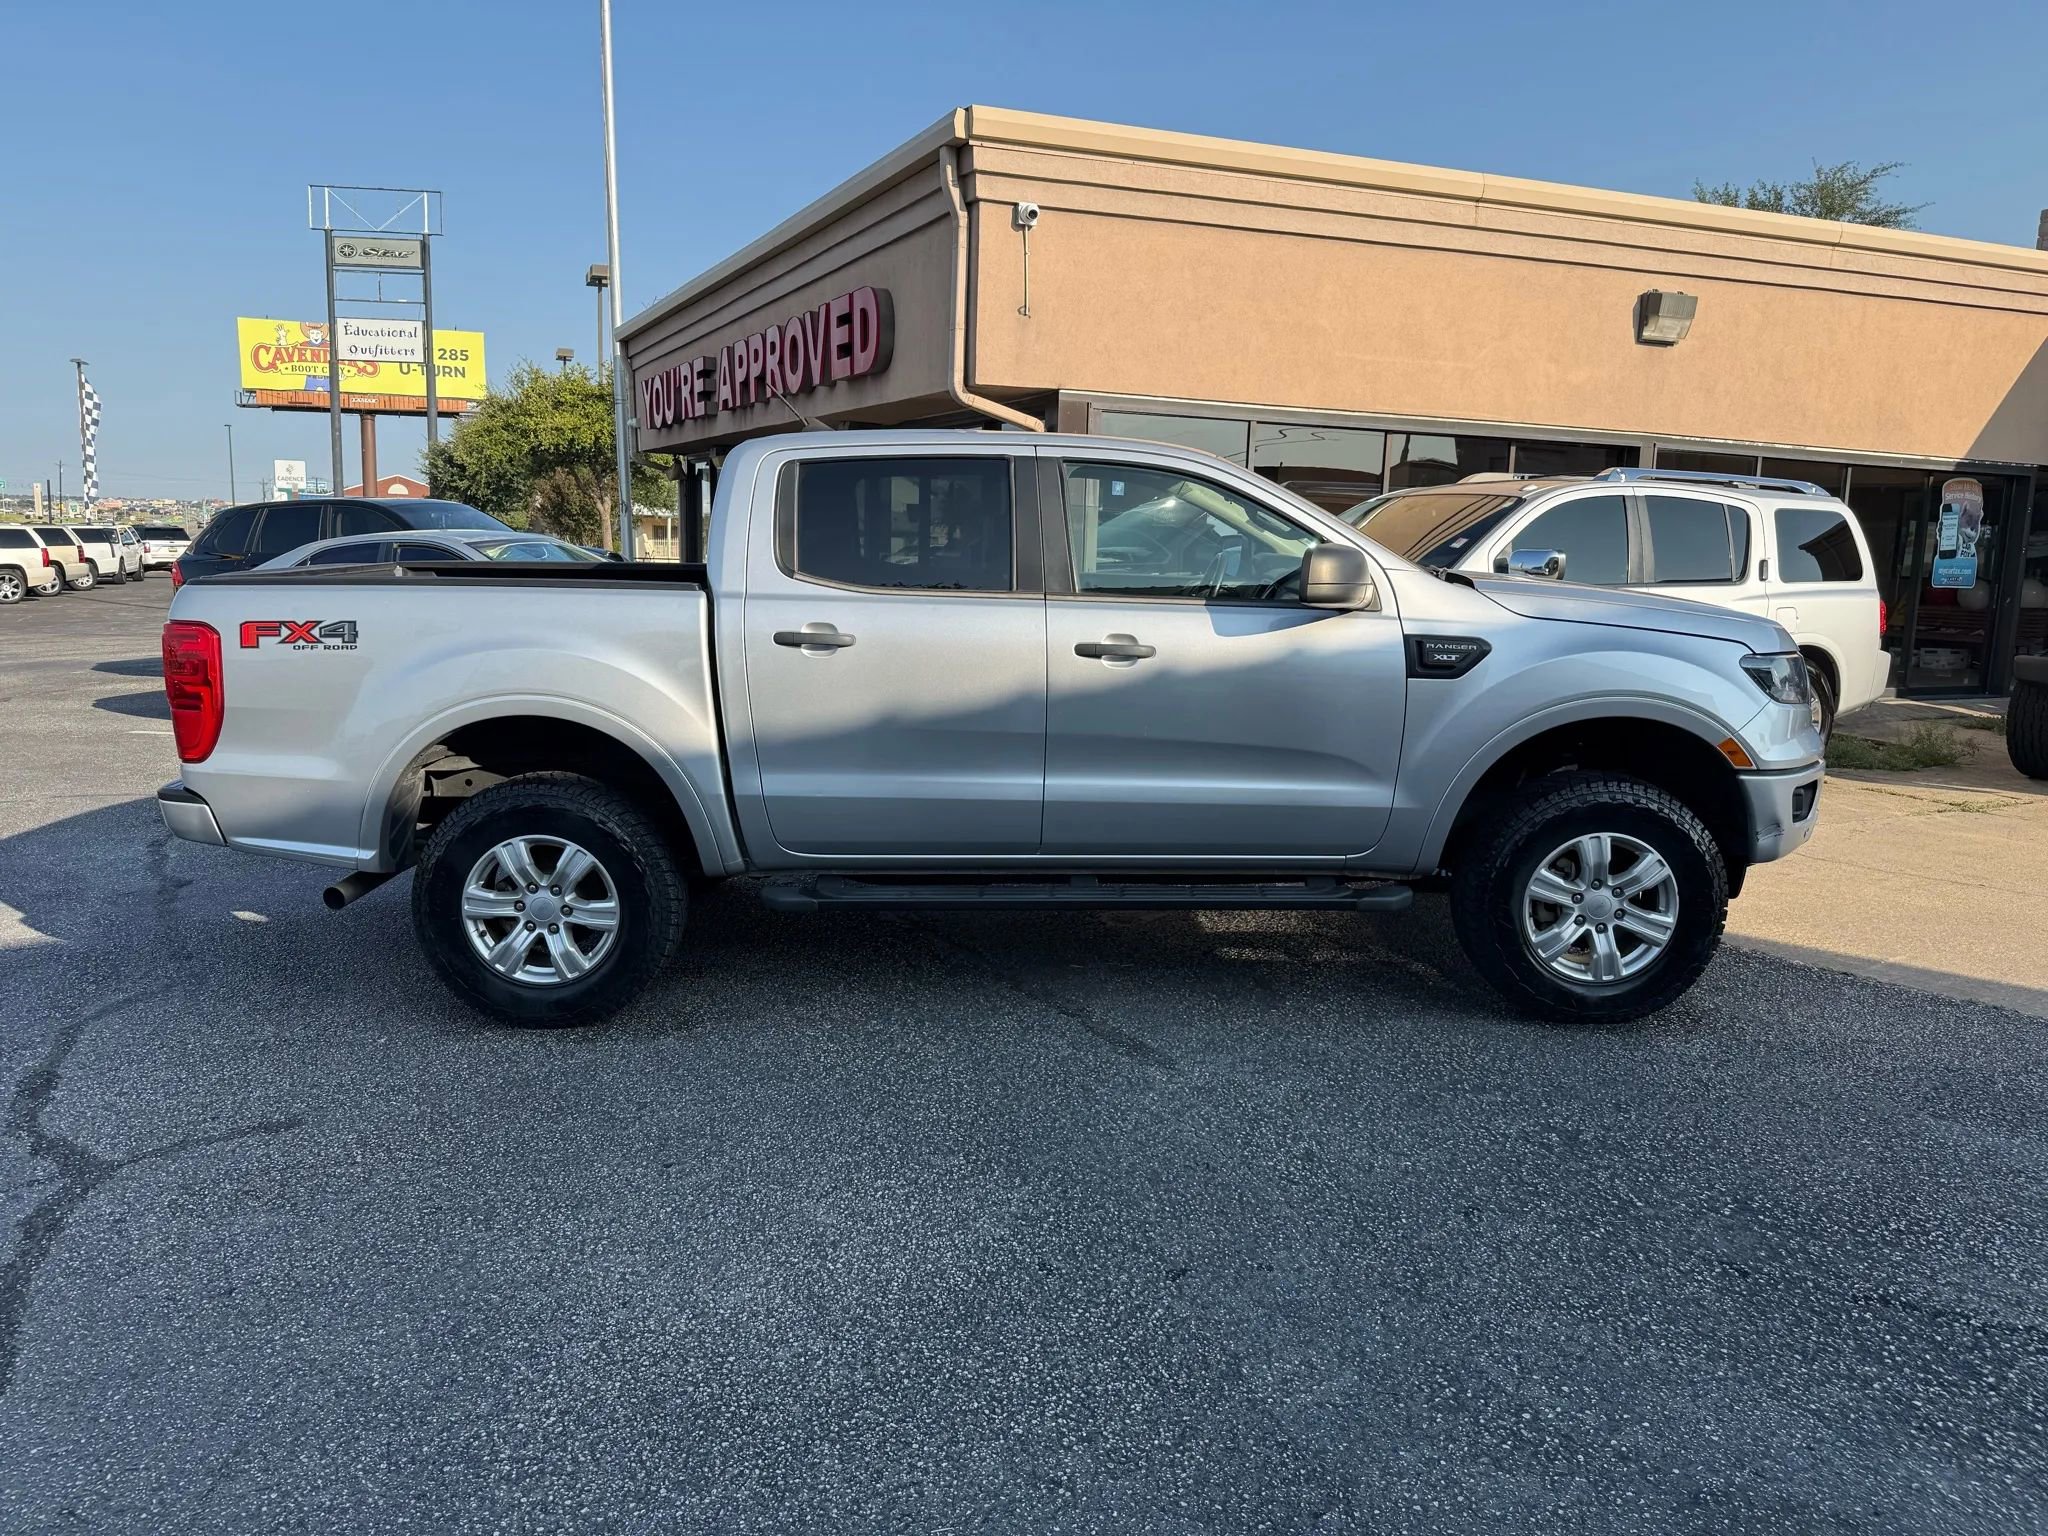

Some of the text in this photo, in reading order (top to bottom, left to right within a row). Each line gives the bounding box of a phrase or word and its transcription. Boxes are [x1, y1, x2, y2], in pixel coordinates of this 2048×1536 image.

[343, 321, 418, 339] Educational
[349, 344, 416, 357] Outfitters
[437, 347, 470, 361] 285
[641, 286, 894, 430] YOU'RE APPROVED
[291, 365, 346, 375] BOOT CY
[240, 620, 359, 649] FX4
